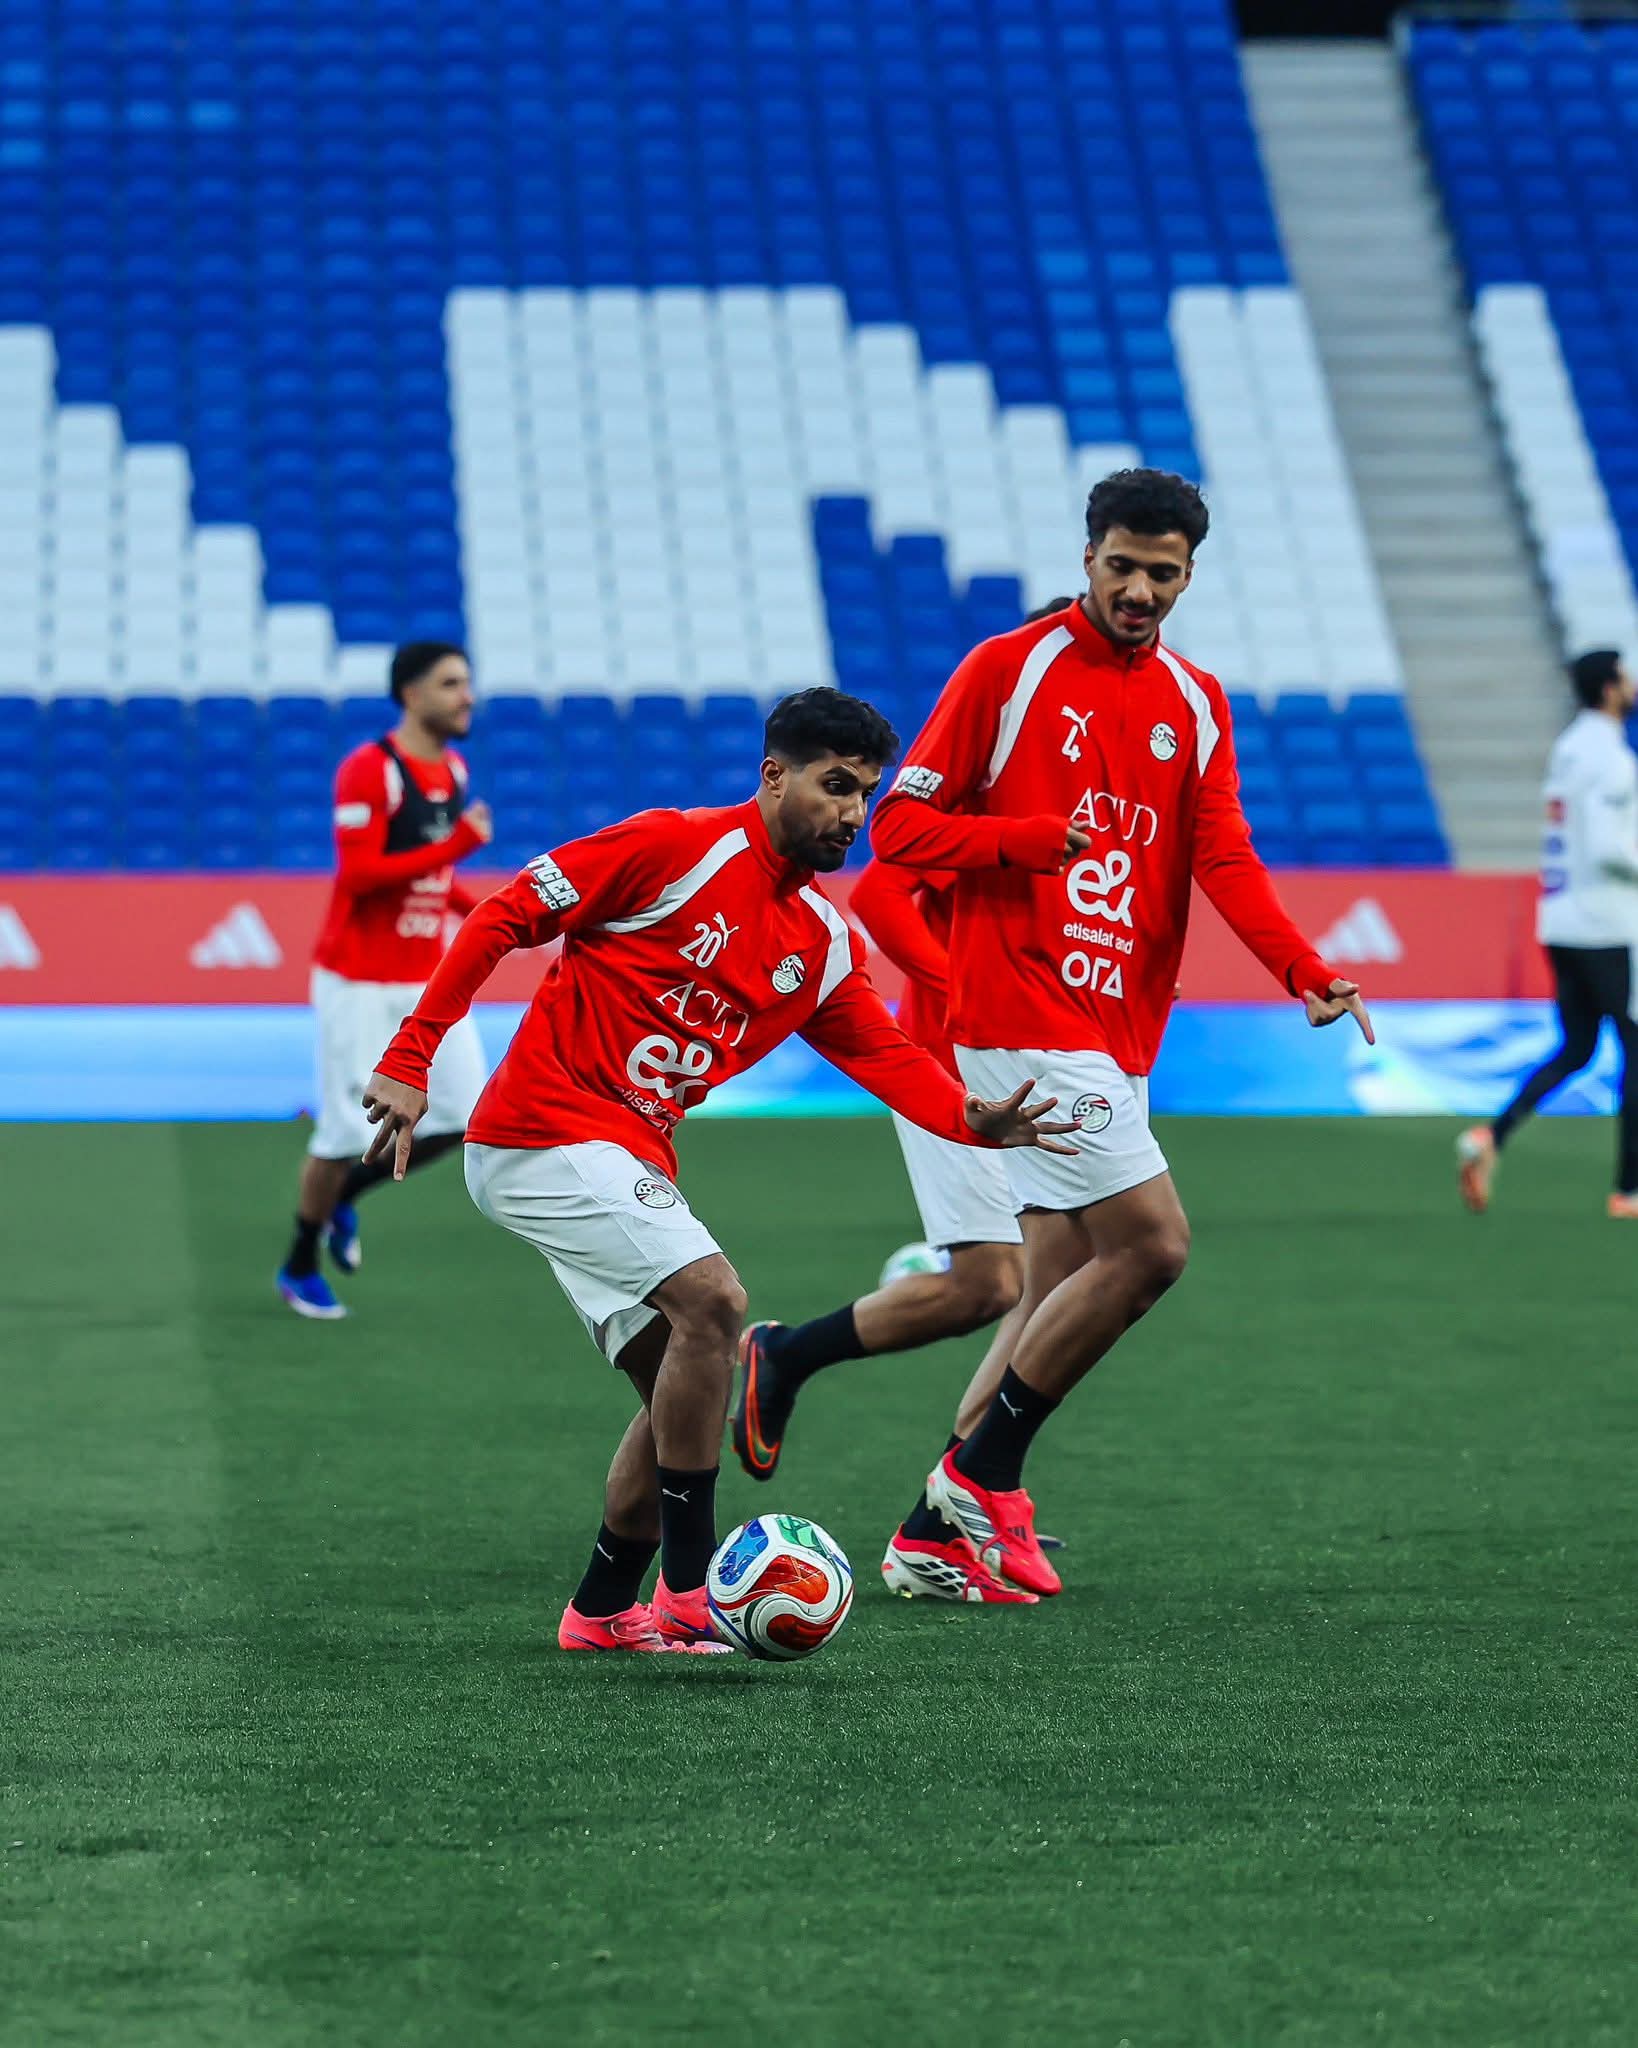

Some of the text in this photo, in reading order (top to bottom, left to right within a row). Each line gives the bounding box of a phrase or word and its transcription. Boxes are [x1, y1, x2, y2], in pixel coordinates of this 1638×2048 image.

[1061, 724, 1082, 763] 4
[678, 922, 723, 969] 20
[1063, 922, 1114, 948] etisalat
